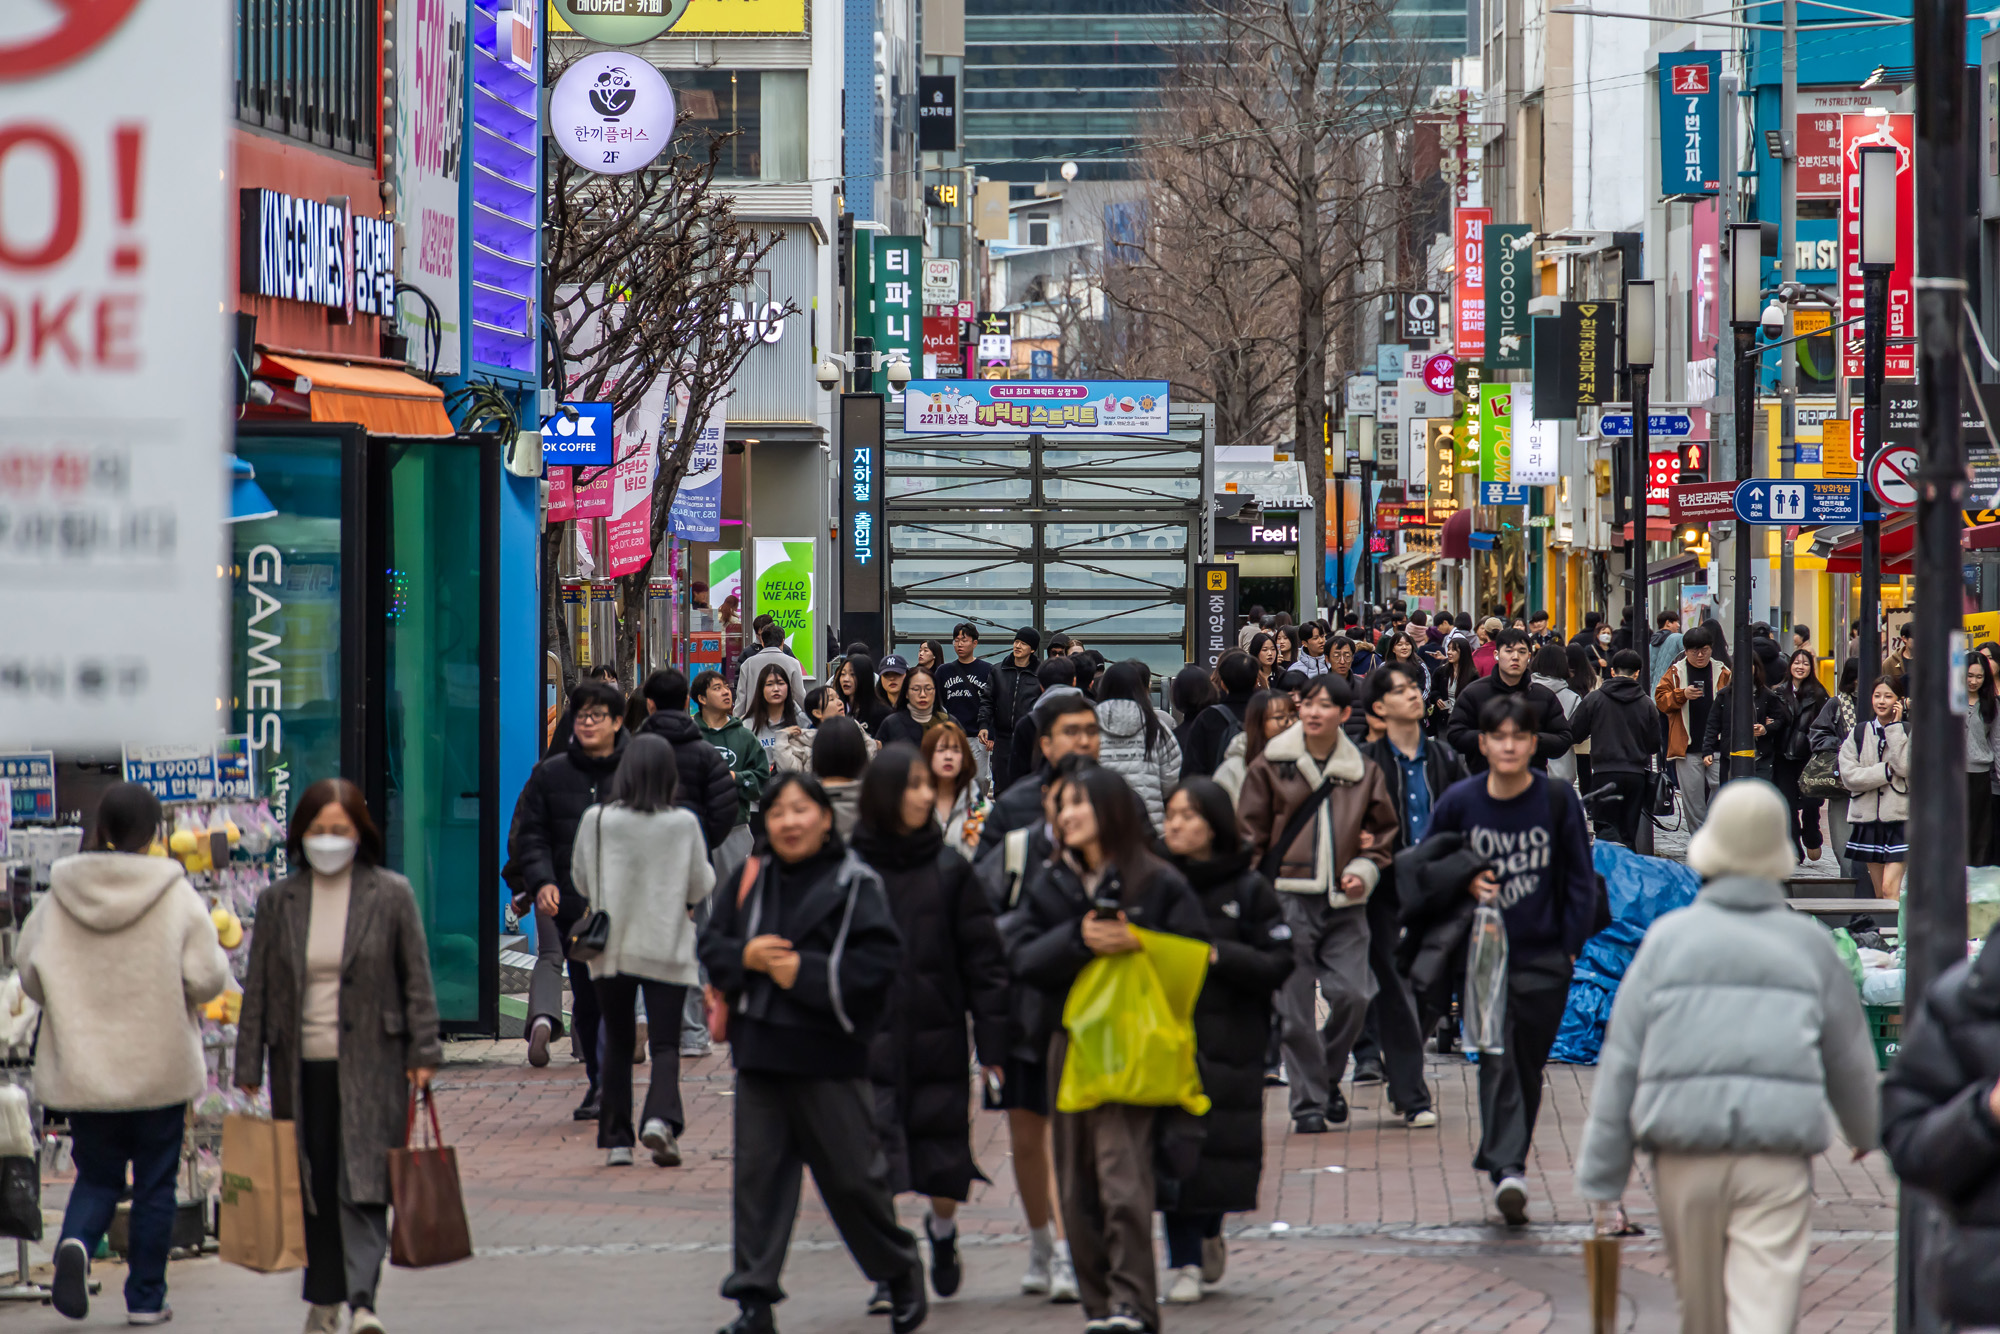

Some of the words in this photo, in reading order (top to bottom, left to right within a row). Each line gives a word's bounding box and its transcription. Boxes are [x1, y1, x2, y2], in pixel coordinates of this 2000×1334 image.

[1815, 98, 1828, 106] 7TH
[1829, 98, 1852, 106] STREET
[1853, 97, 1872, 105] PIZZA
[1814, 120, 1833, 132] 1인용
[574, 125, 650, 144] 한끼플러스
[1684, 97, 1702, 182] 7번가피자
[602, 151, 620, 164] 2F
[260, 187, 293, 299] KING
[295, 197, 344, 308] GAMES
[1465, 219, 1482, 288] 제이원
[1816, 240, 1838, 270] ST
[930, 264, 950, 274] CCR
[1500, 232, 1515, 345] CROCODIL
[1578, 318, 1598, 404] 한국공인금거래소
[1033, 388, 1054, 396] 캐릭터
[1057, 388, 1078, 396] 상점가
[920, 413, 944, 424] 22개
[947, 413, 968, 424] 상점
[978, 402, 1028, 424] 캐릭터
[1031, 406, 1096, 426] 스트리트
[1623, 416, 1667, 426] 국상로
[558, 442, 596, 452] COFFEE
[853, 446, 872, 502] 지하철
[1813, 484, 1851, 493] 개방화장실
[854, 512, 872, 564] 출입구
[1252, 526, 1287, 542] Feel
[1290, 527, 1298, 542] t
[766, 582, 804, 590] HELLO
[763, 592, 782, 600] WE
[784, 592, 806, 600] ARE
[767, 610, 802, 618] OLIVE
[774, 620, 806, 628] OUNG
[1973, 624, 1986, 632] DAY
[247, 544, 282, 755] GAMES
